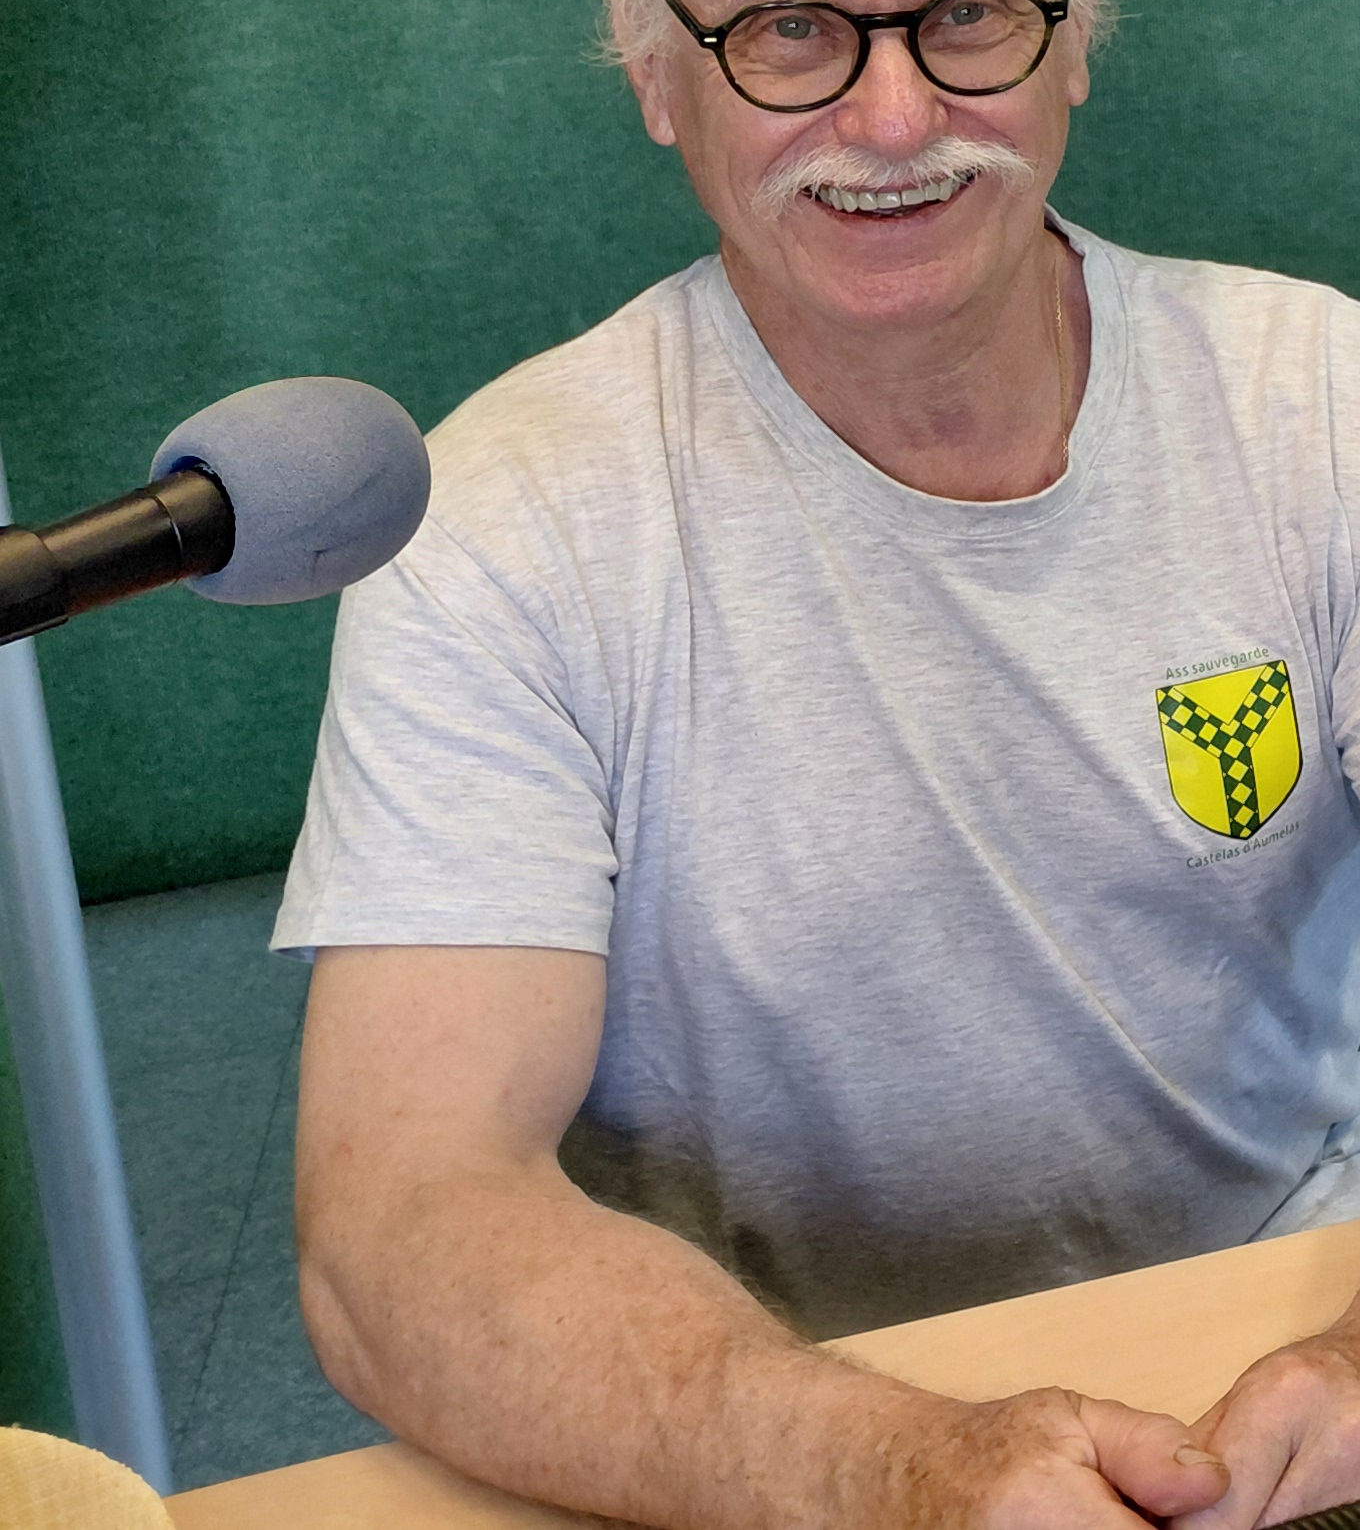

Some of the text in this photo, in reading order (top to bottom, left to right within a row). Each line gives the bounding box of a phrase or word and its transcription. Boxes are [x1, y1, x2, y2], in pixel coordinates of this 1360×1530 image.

[1166, 647, 1270, 680] Ass sauvegarde
[1186, 821, 1300, 868] Castelas d'Aumelas
